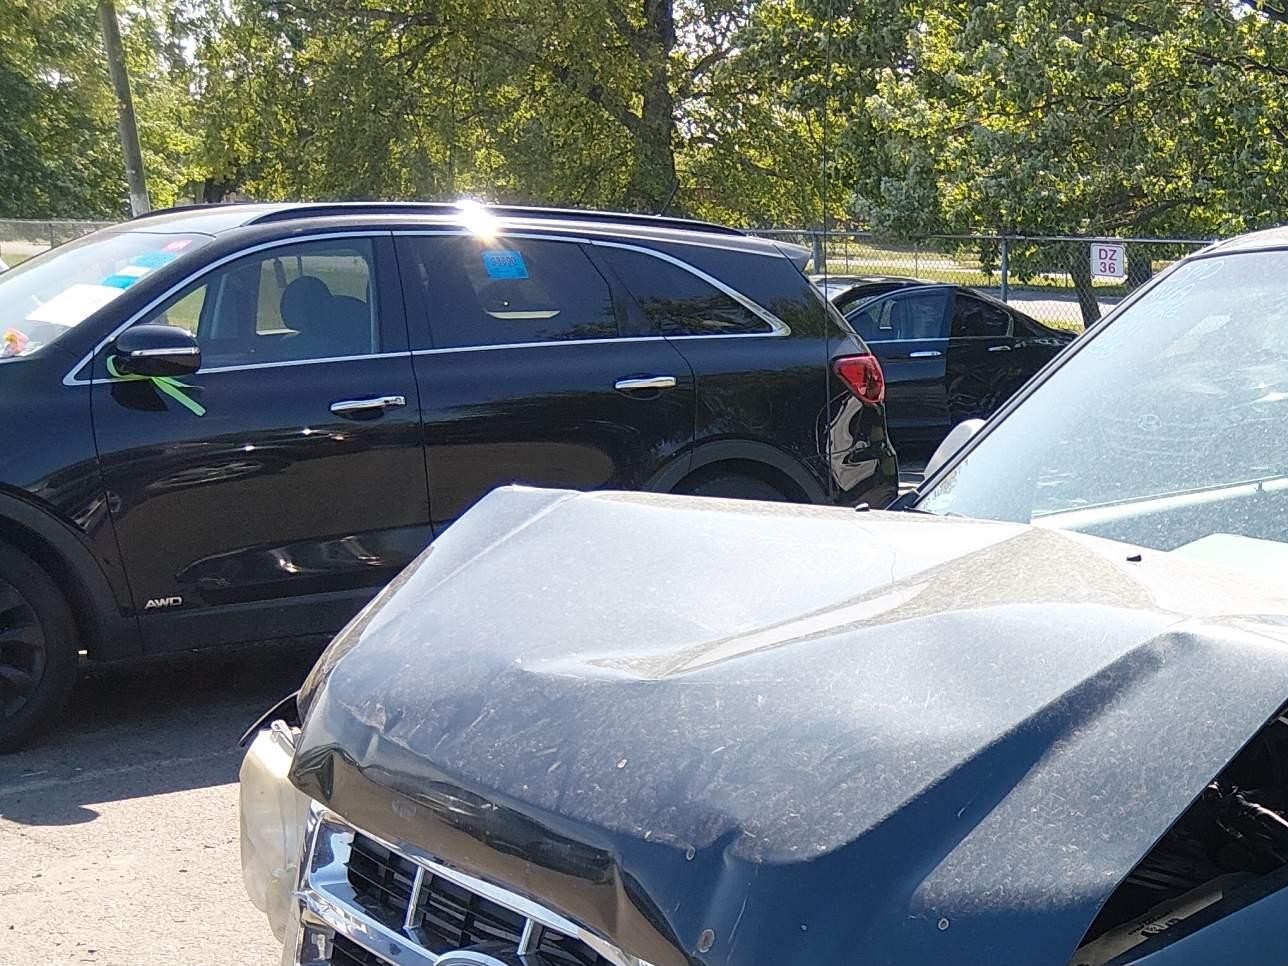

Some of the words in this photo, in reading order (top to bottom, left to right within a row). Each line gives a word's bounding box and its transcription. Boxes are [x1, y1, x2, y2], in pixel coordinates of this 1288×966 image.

[1098, 248, 1118, 261] DZ
[1099, 261, 1116, 274] 36
[143, 596, 183, 610] AWD
